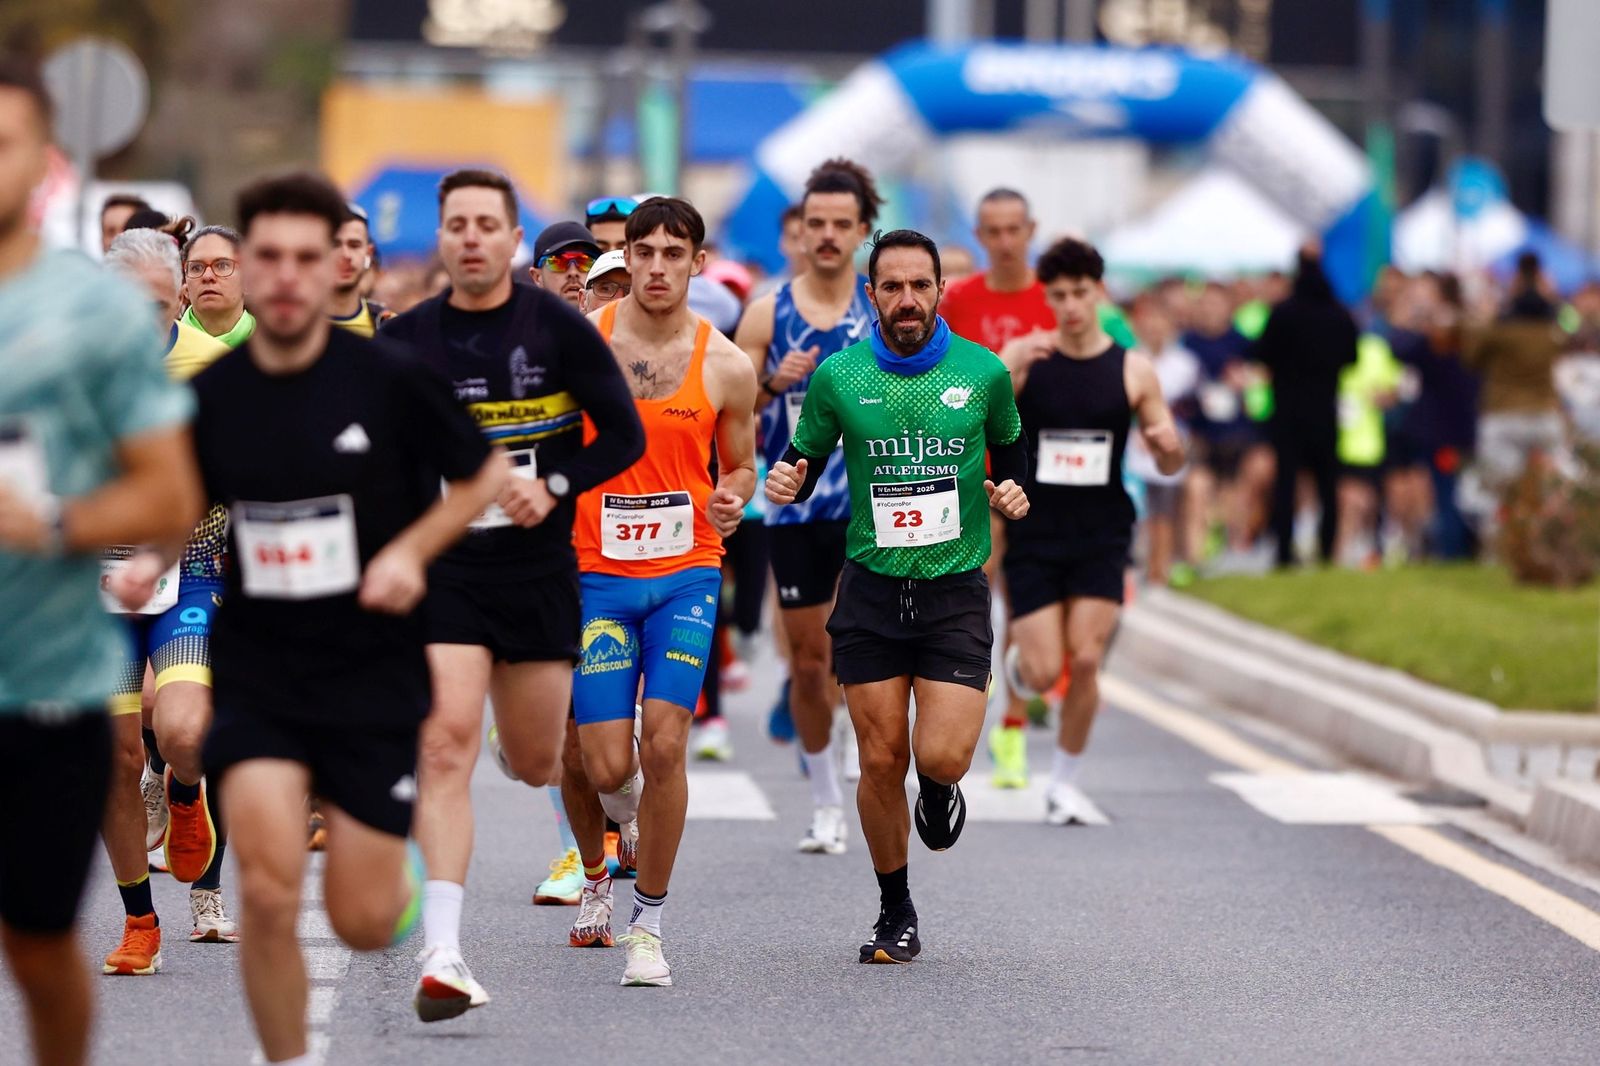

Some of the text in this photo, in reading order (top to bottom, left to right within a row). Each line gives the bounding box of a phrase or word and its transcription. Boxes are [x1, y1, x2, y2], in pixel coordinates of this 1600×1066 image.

[865, 429, 966, 464] mijas
[873, 464, 959, 476] ATLETISMO
[916, 484, 935, 493] 2026
[650, 497, 670, 506] 2026
[892, 509, 923, 528] 23
[616, 522, 661, 541] 377
[673, 614, 700, 624] Ponciano
[581, 661, 605, 676] LOCOS
[610, 658, 633, 671] COLINA
